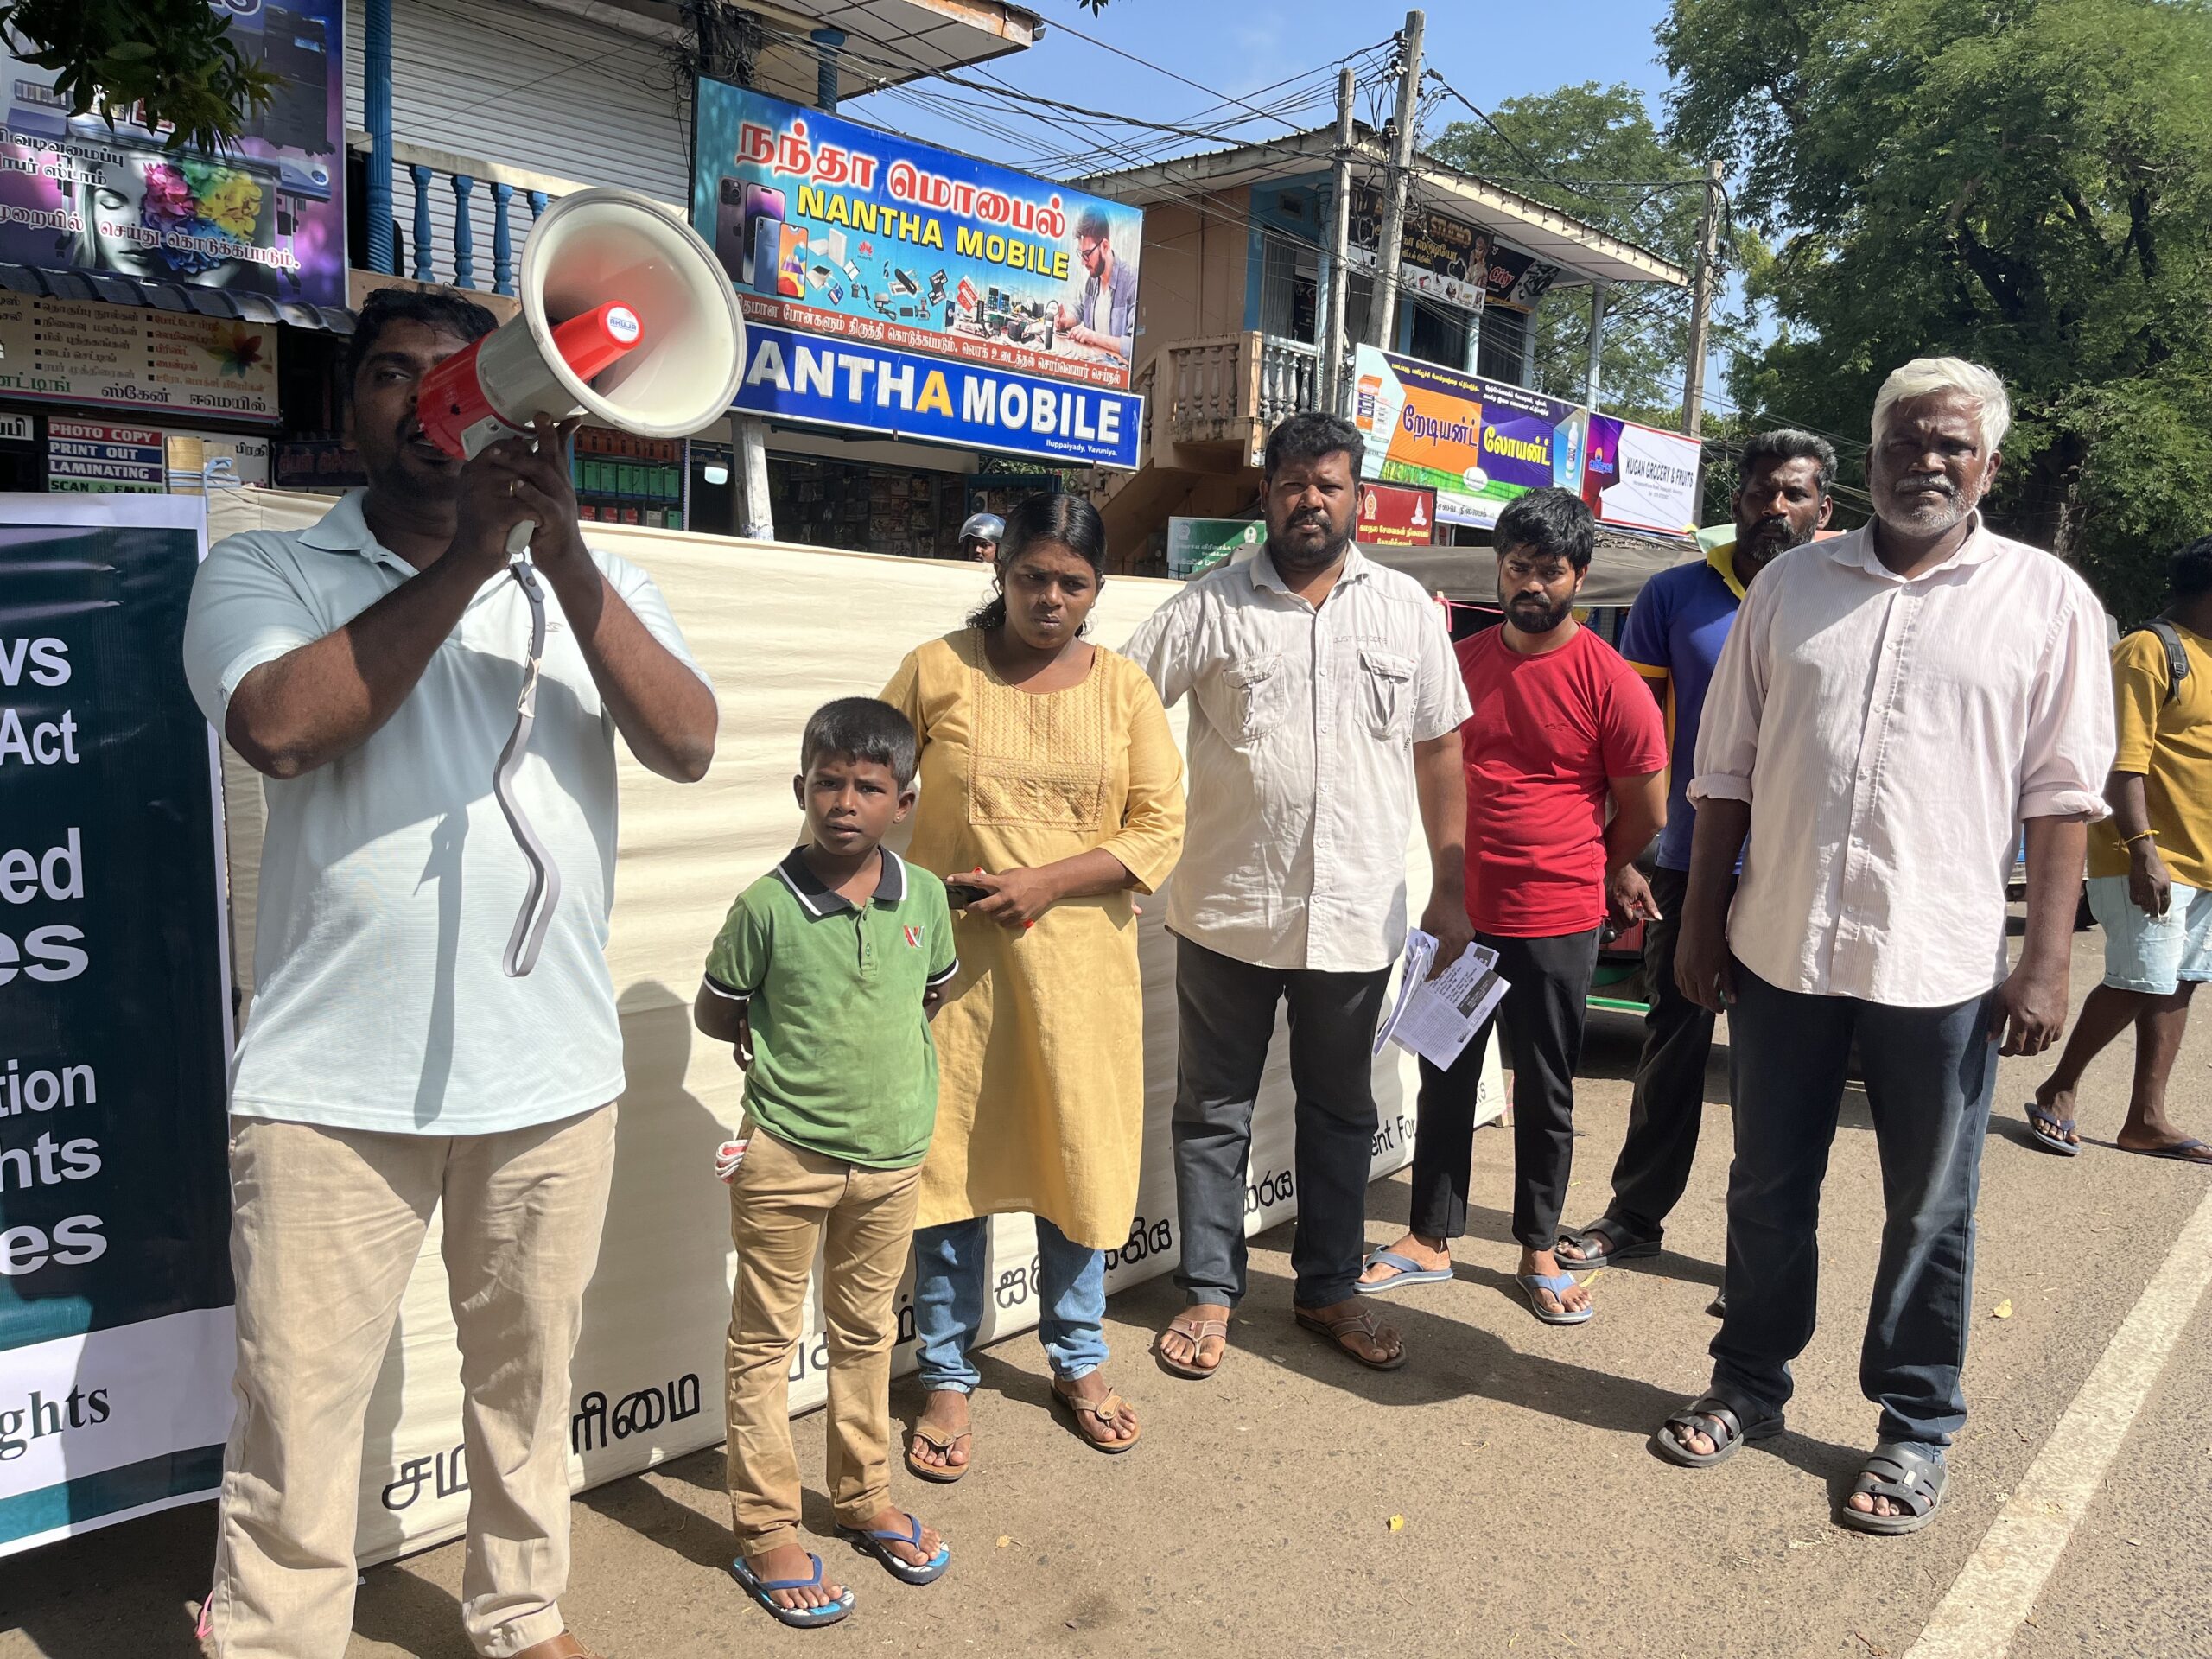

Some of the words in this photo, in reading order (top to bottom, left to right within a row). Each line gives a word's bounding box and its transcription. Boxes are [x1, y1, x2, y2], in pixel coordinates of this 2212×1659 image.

[14, 134, 124, 167] வடிவமைப்பு
[736, 122, 874, 188] நந்தா
[887, 163, 1065, 238] மொபைல்
[100, 222, 160, 246] செய்து
[798, 185, 944, 249] NANTHA
[957, 226, 1070, 280] MOBILE
[610, 318, 637, 331] AHUJA
[102, 383, 171, 404] ஸ்கேன்
[190, 393, 266, 412] ஈமெயில்
[747, 339, 953, 417] ANTHA
[962, 375, 1122, 443] MOBILE
[49, 423, 103, 438] PHOTO
[111, 429, 152, 443] COPY
[1046, 439, 1085, 453] Iluppaiyady,
[1088, 445, 1117, 456] Vavuniya.
[49, 442, 99, 456] PRINT
[105, 447, 138, 460] OUT
[50, 461, 149, 479] LAMINATING
[51, 480, 89, 493] SCAN
[1625, 456, 1645, 478] KUGAN
[1646, 461, 1671, 482] GROCERY
[1670, 467, 1675, 484] &
[1675, 468, 1694, 488] FRUITS
[0, 709, 79, 765] Act
[0, 827, 84, 904] ed
[1371, 1120, 1394, 1156] ent
[0, 1214, 107, 1275] es
[0, 1387, 110, 1459] ghts
[572, 1373, 701, 1457] ரிமை
